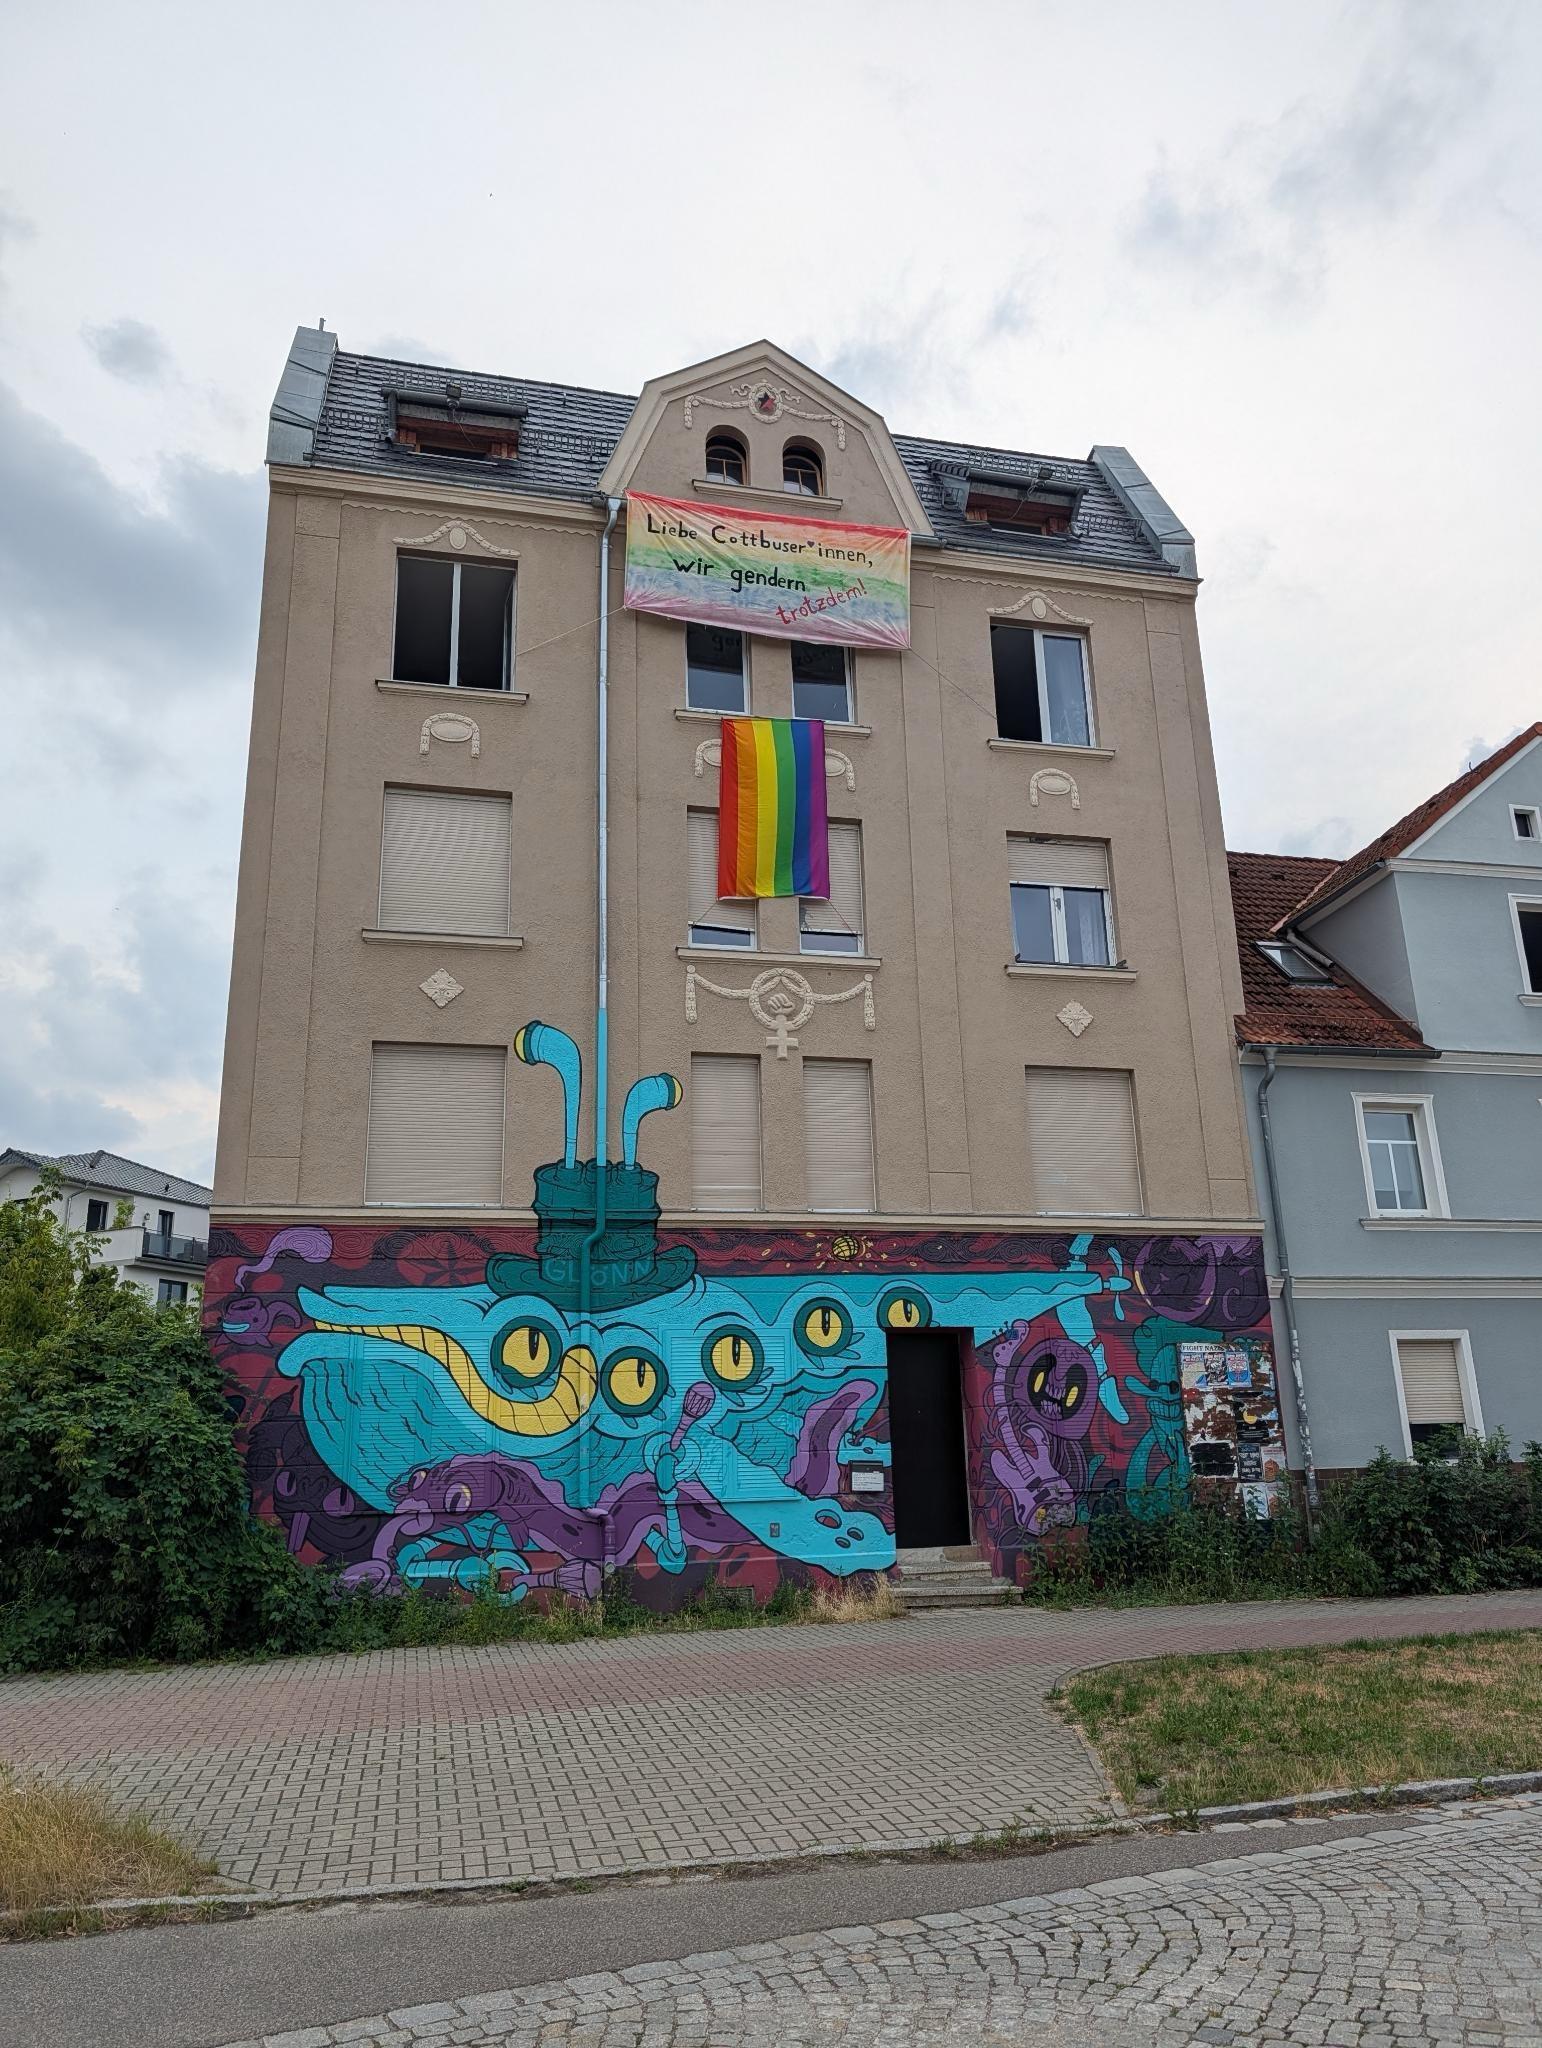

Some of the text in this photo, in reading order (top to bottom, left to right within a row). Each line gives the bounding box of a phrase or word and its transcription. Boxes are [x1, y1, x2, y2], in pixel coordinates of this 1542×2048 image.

[647, 513, 698, 540] Liebe
[672, 558, 806, 593] wir gendern
[776, 577, 867, 625] trotzdem!
